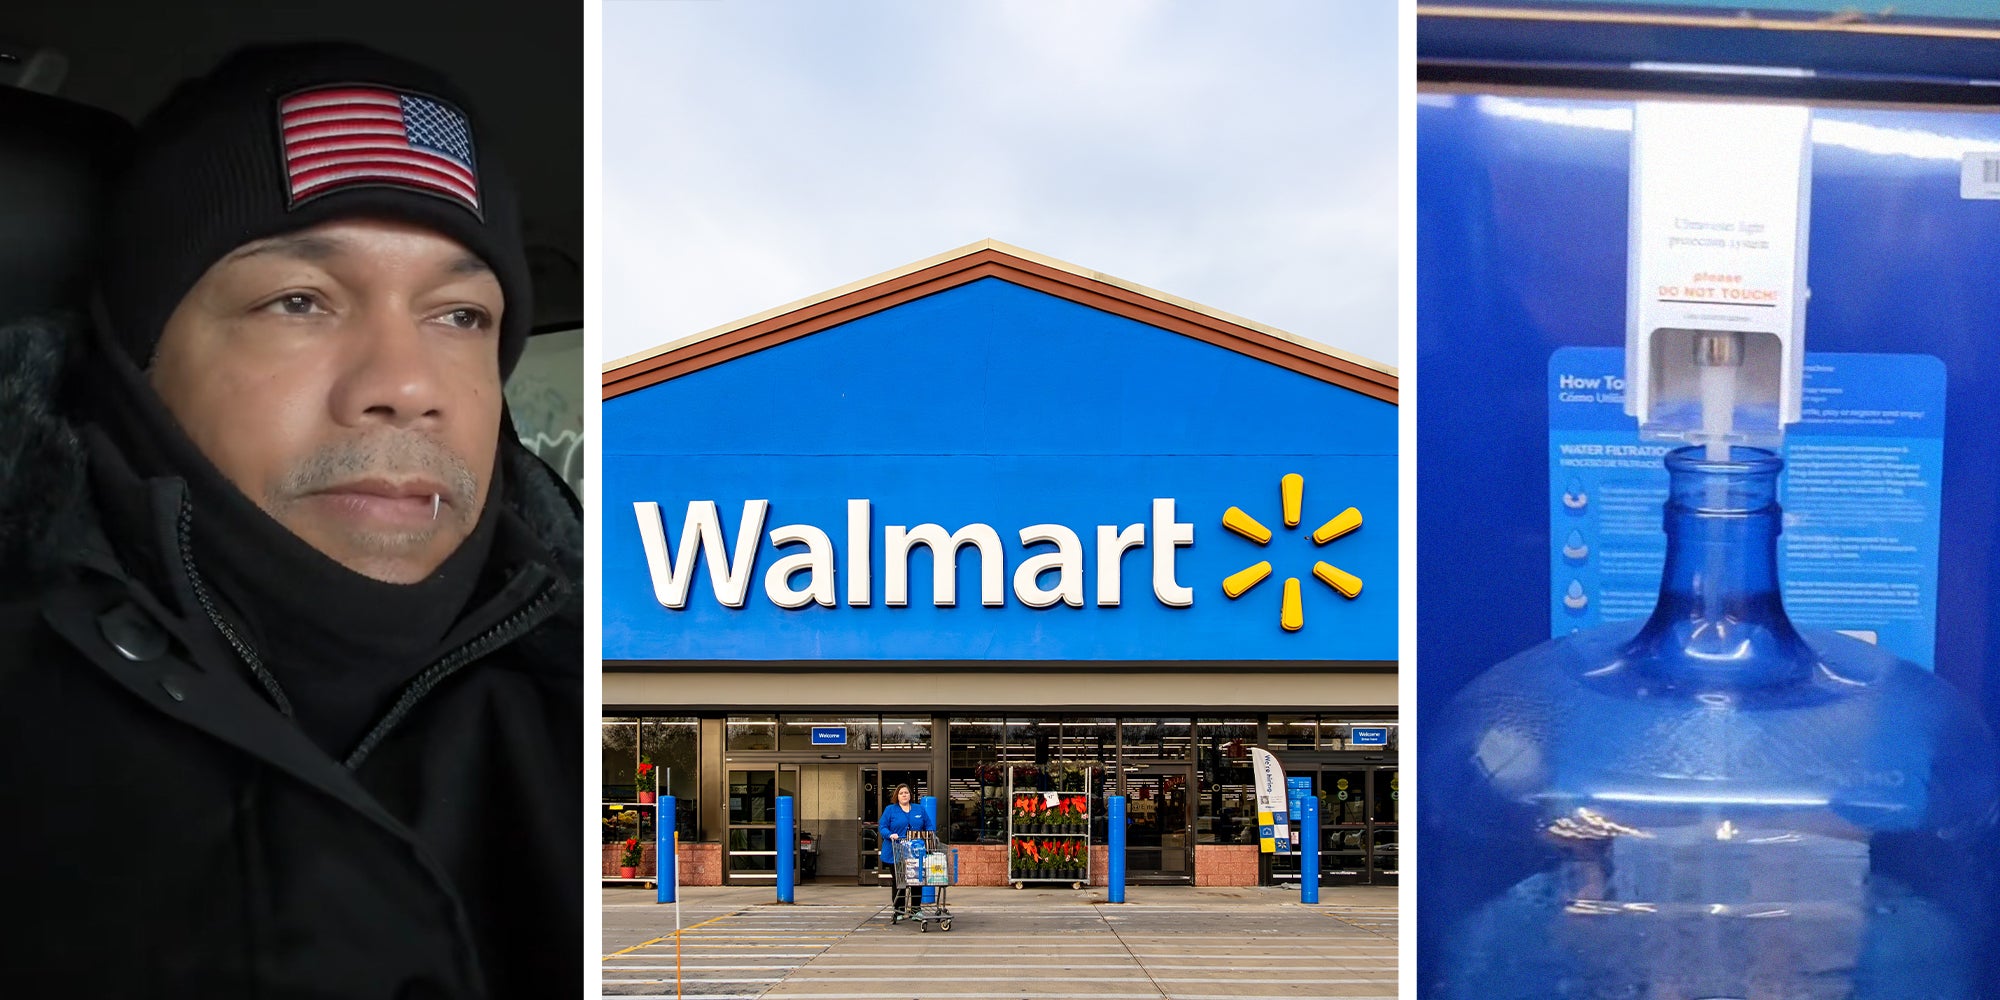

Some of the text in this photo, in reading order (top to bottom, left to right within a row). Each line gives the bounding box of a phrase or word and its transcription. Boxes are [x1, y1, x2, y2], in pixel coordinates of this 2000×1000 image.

[1693, 271, 1742, 284] please
[1657, 285, 1679, 298] DO
[1684, 286, 1715, 299] NOT
[1559, 374, 1625, 390] How To
[1559, 444, 1603, 456] WATER
[633, 497, 1195, 609] Walmart
